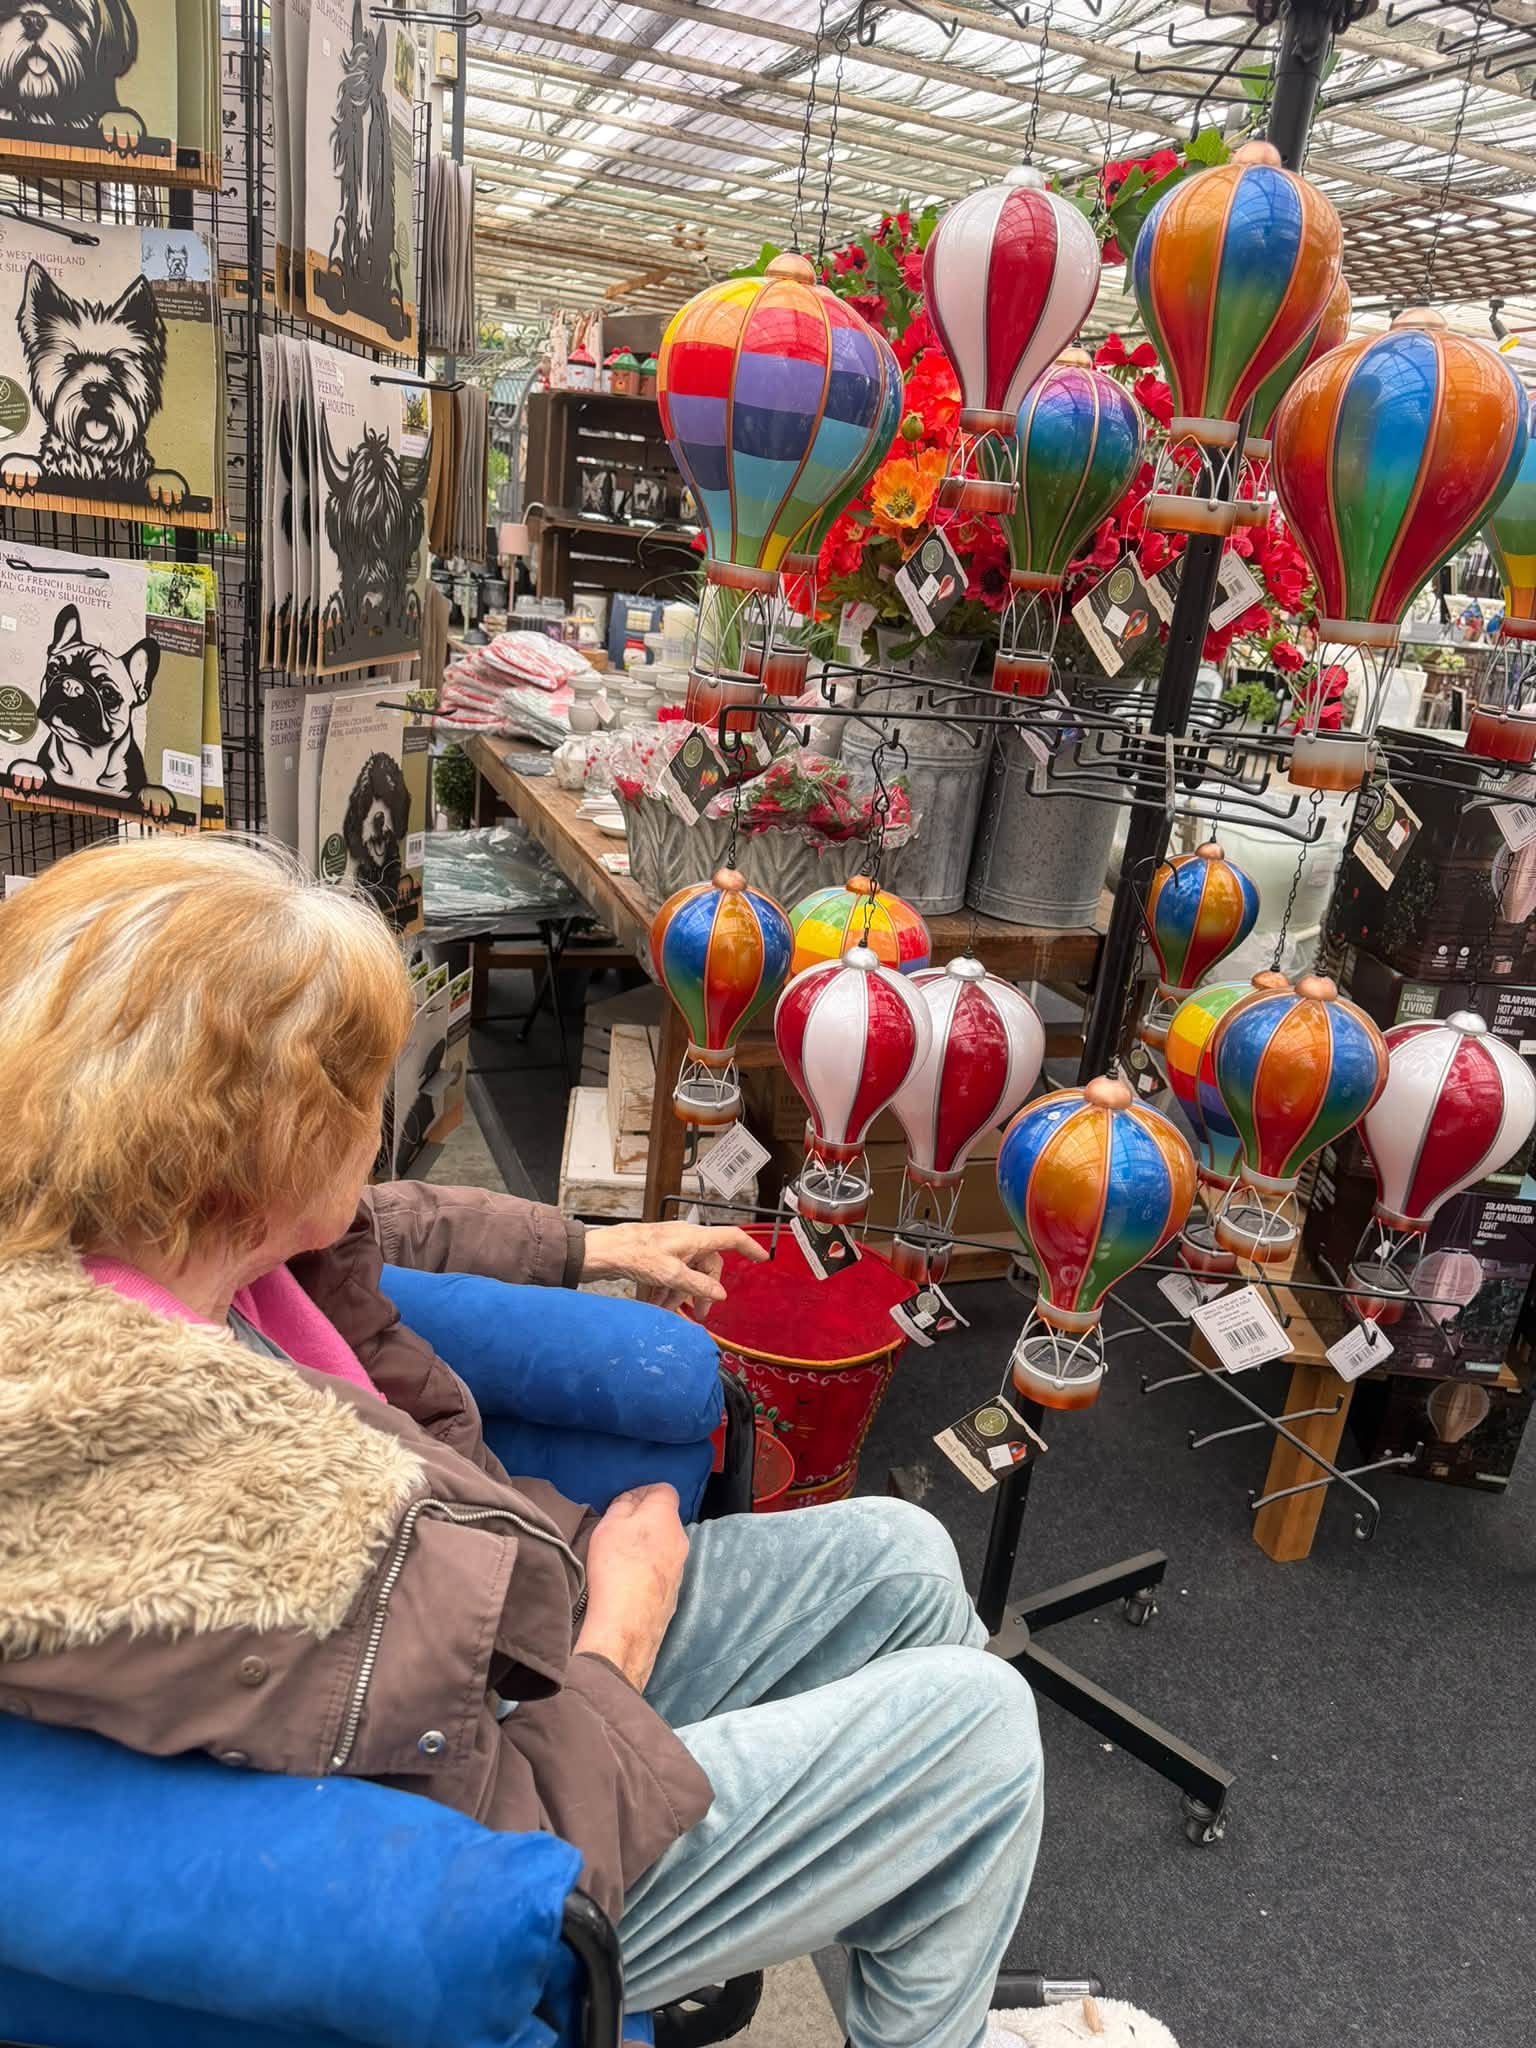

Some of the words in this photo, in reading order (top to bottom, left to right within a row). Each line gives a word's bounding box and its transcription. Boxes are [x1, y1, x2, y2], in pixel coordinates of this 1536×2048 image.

[7, 250, 33, 260] WEST
[36, 253, 86, 266] HIGHLAND
[6, 263, 65, 277] SILHTTE
[1, 570, 24, 582] KING
[27, 575, 63, 589] FRENCH
[66, 582, 108, 598] BULLDOG
[0, 580, 15, 591] TAL
[17, 584, 56, 598] GARDEN
[58, 591, 113, 609] SILHOUETTE
[1403, 993, 1435, 1003] OUTDOOR
[1499, 994, 1521, 1004] SOLAR
[1400, 1002, 1433, 1014] LIVING
[1496, 1004, 1512, 1014] HOT
[1511, 1006, 1523, 1016] AIR
[1494, 1015, 1515, 1026] LIGHT
[1485, 1202, 1505, 1211] SOLAR
[1504, 1203, 1533, 1214] POWERED
[1482, 1211, 1497, 1220] HOT
[1495, 1213, 1507, 1222] AIR
[1506, 1213, 1535, 1225] BALLOON
[1479, 1221, 1499, 1231] LIGHT
